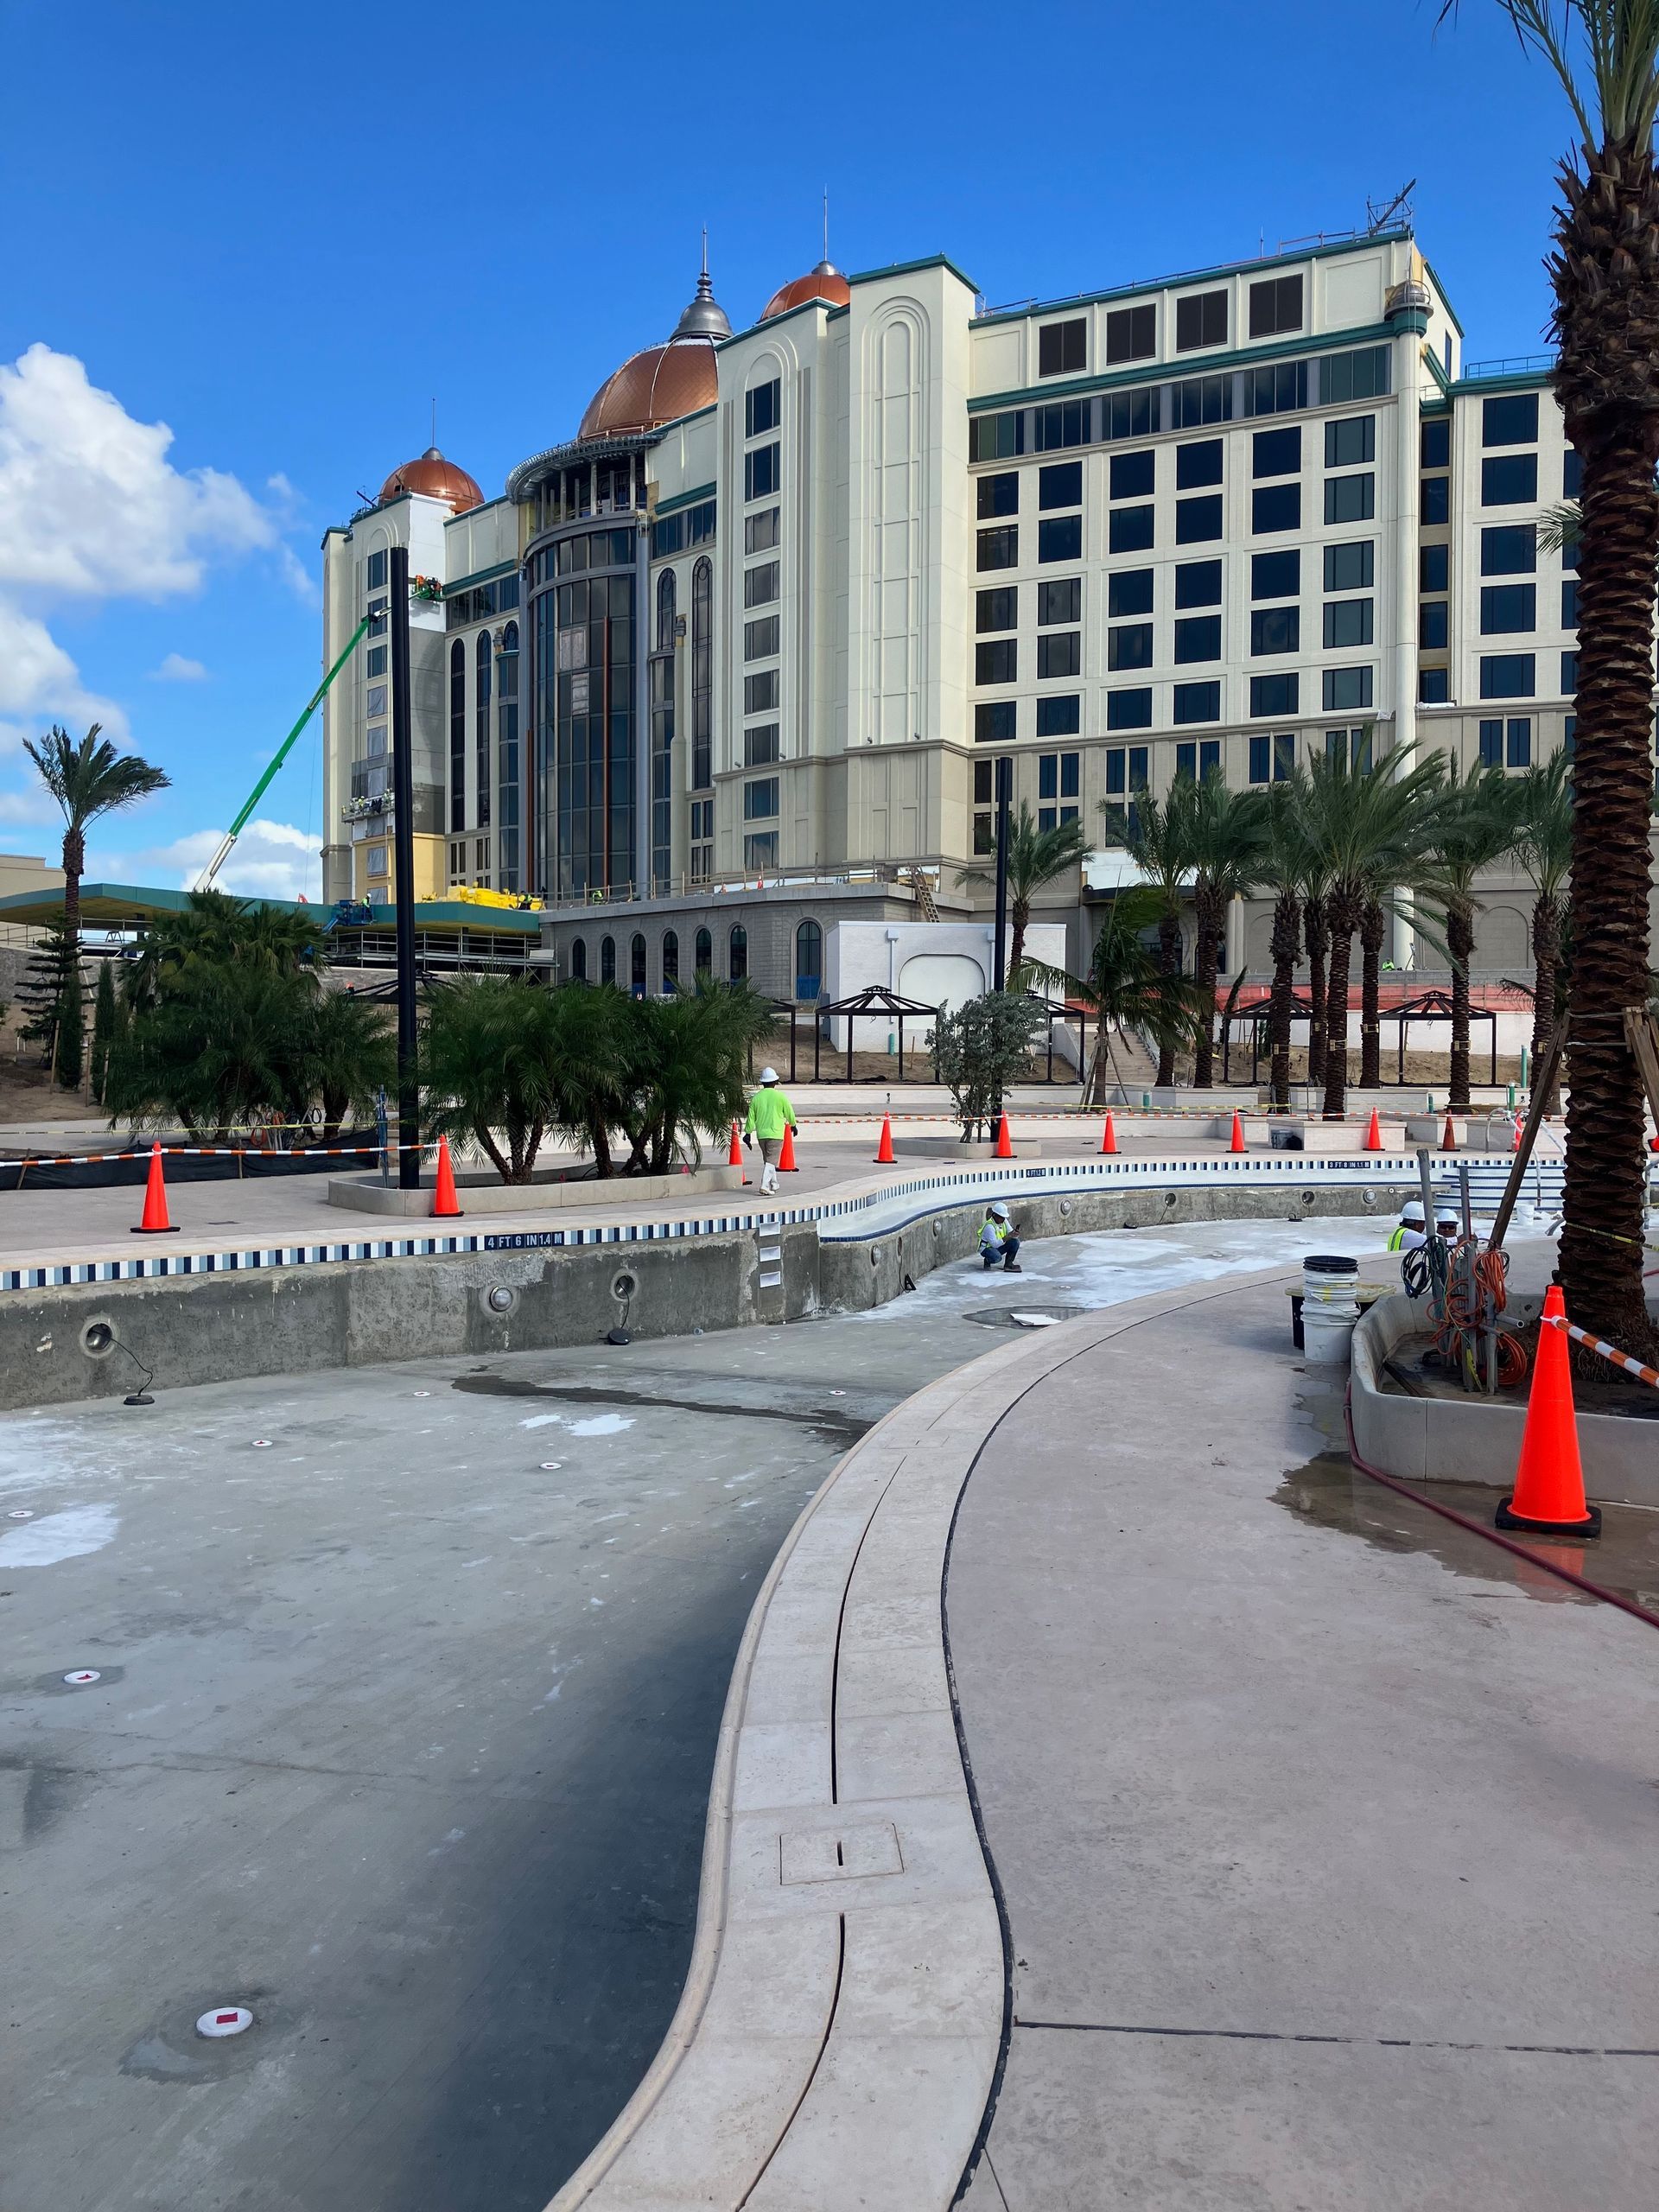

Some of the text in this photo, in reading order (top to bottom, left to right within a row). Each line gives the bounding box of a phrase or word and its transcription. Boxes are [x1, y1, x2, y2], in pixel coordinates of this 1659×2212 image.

[487, 1233, 563, 1248] 4 FT 6 IN 1.4 M
